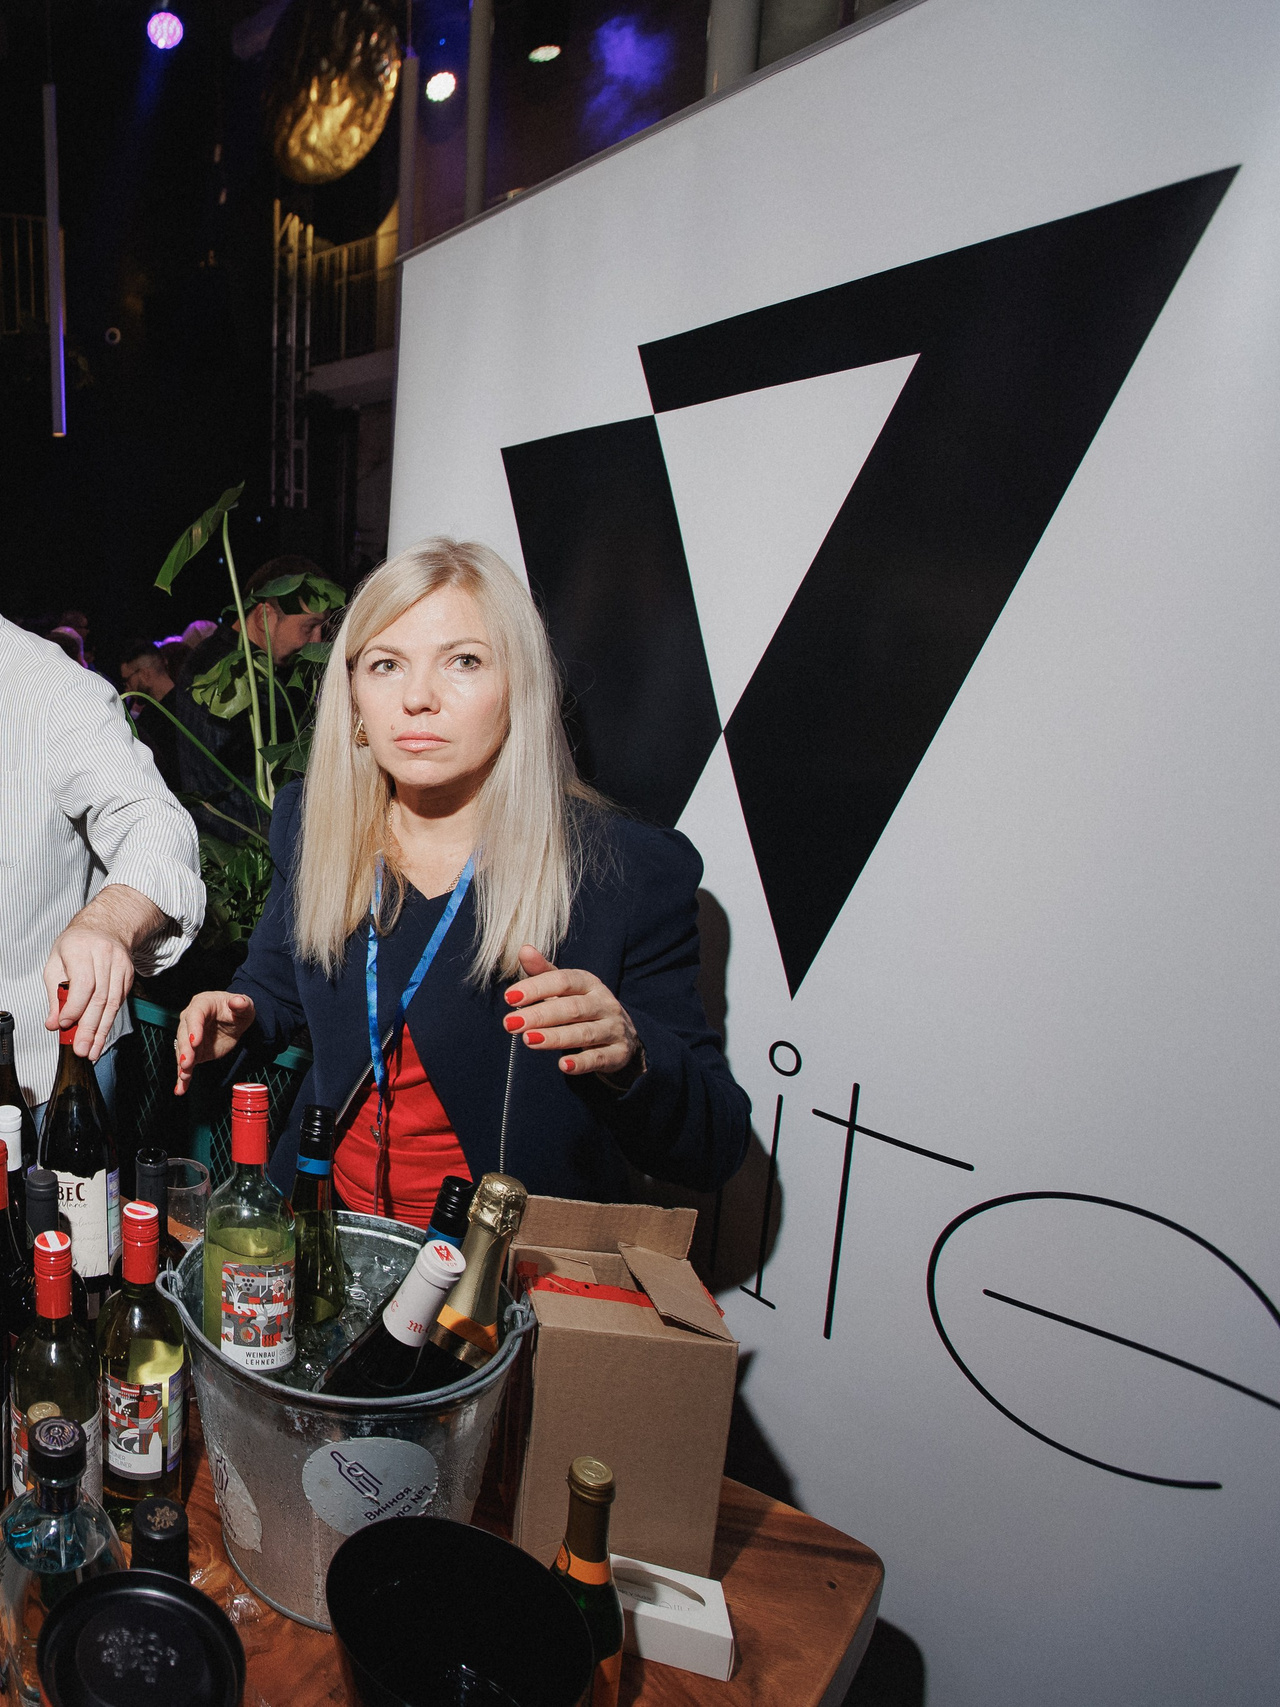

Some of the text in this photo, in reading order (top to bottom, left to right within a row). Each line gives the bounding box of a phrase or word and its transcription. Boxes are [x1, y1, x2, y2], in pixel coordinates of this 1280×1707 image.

[58, 1182, 86, 1201] BEC
[245, 1350, 276, 1359] WEINBAU
[245, 1358, 275, 1366] LEHNER
[364, 1486, 412, 1521] Винная
